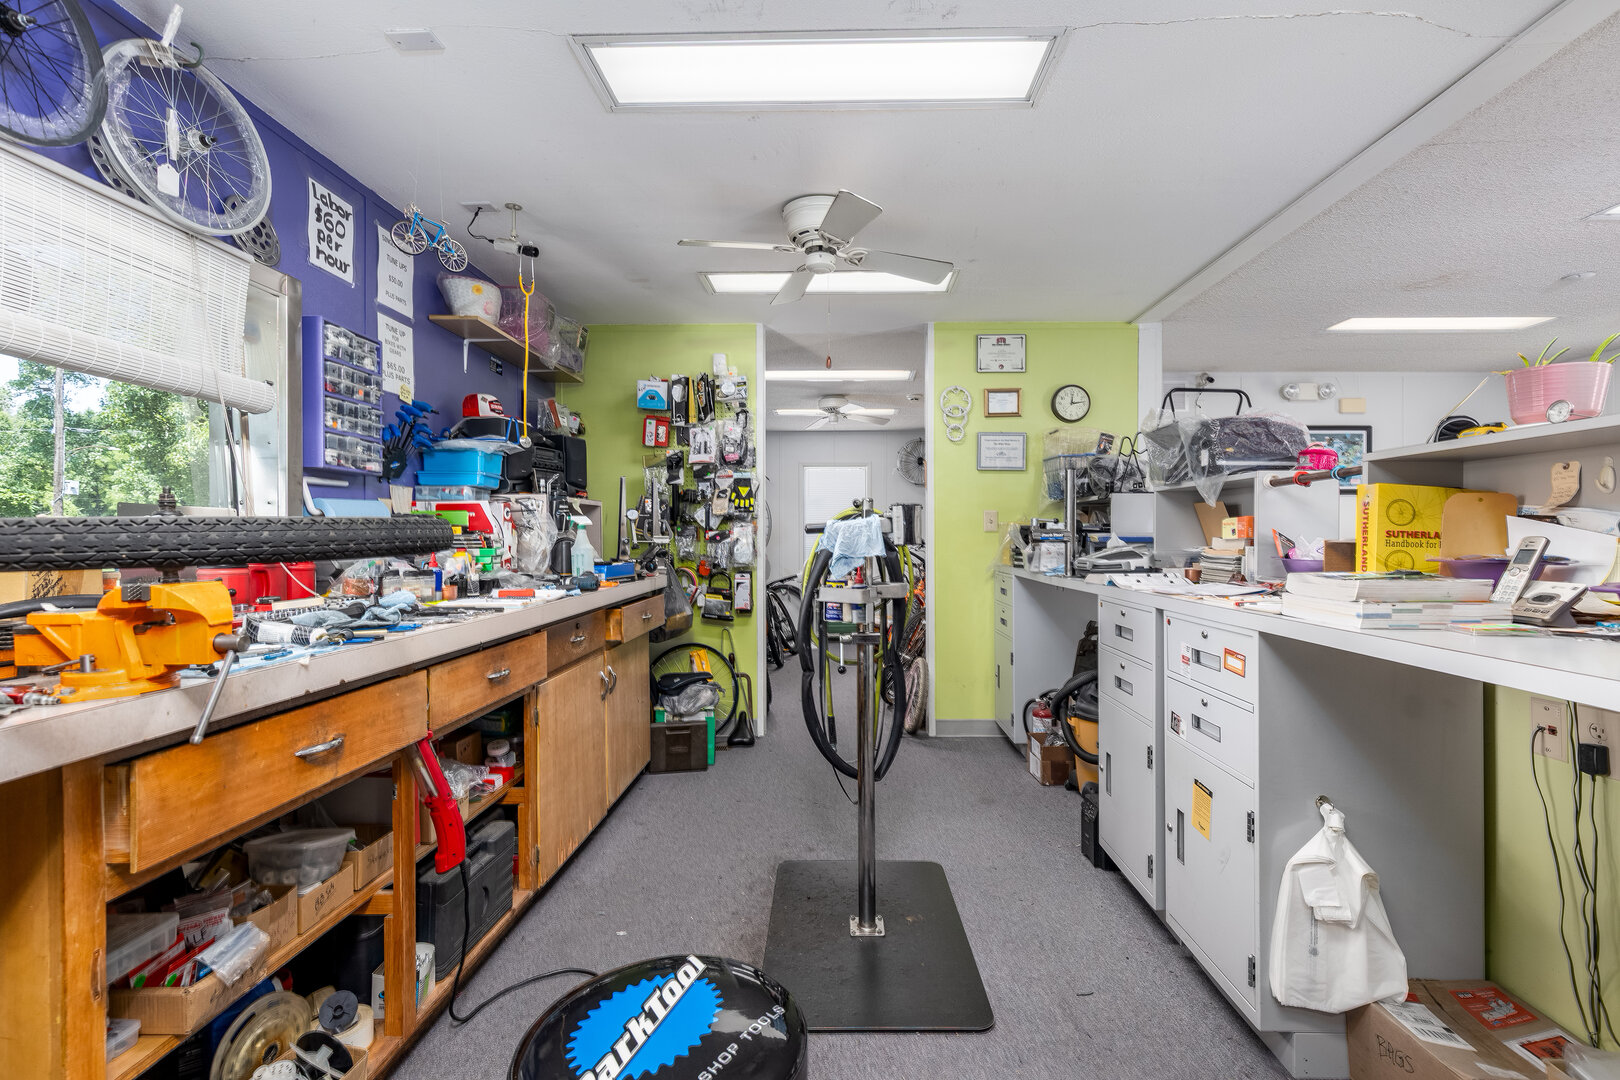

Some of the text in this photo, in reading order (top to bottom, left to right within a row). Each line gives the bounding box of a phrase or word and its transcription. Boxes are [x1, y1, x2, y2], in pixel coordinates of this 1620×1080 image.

[311, 182, 352, 221] Labor
[314, 203, 346, 239] $60
[316, 228, 343, 252] per
[386, 253, 408, 273] TUNE UPS
[388, 274, 404, 288] $50.00
[385, 290, 407, 306] PLUS PARTS
[385, 323, 406, 339] TUNE UP
[386, 361, 406, 375] $65.00
[395, 373, 411, 385] PARTS
[1361, 501, 1369, 572] SUTHERLAND
[1385, 539, 1424, 549] Handbook
[1425, 541, 1438, 549] for
[698, 1004, 786, 1080] SHOP TOOLS
[1376, 1034, 1415, 1074] BAGS
